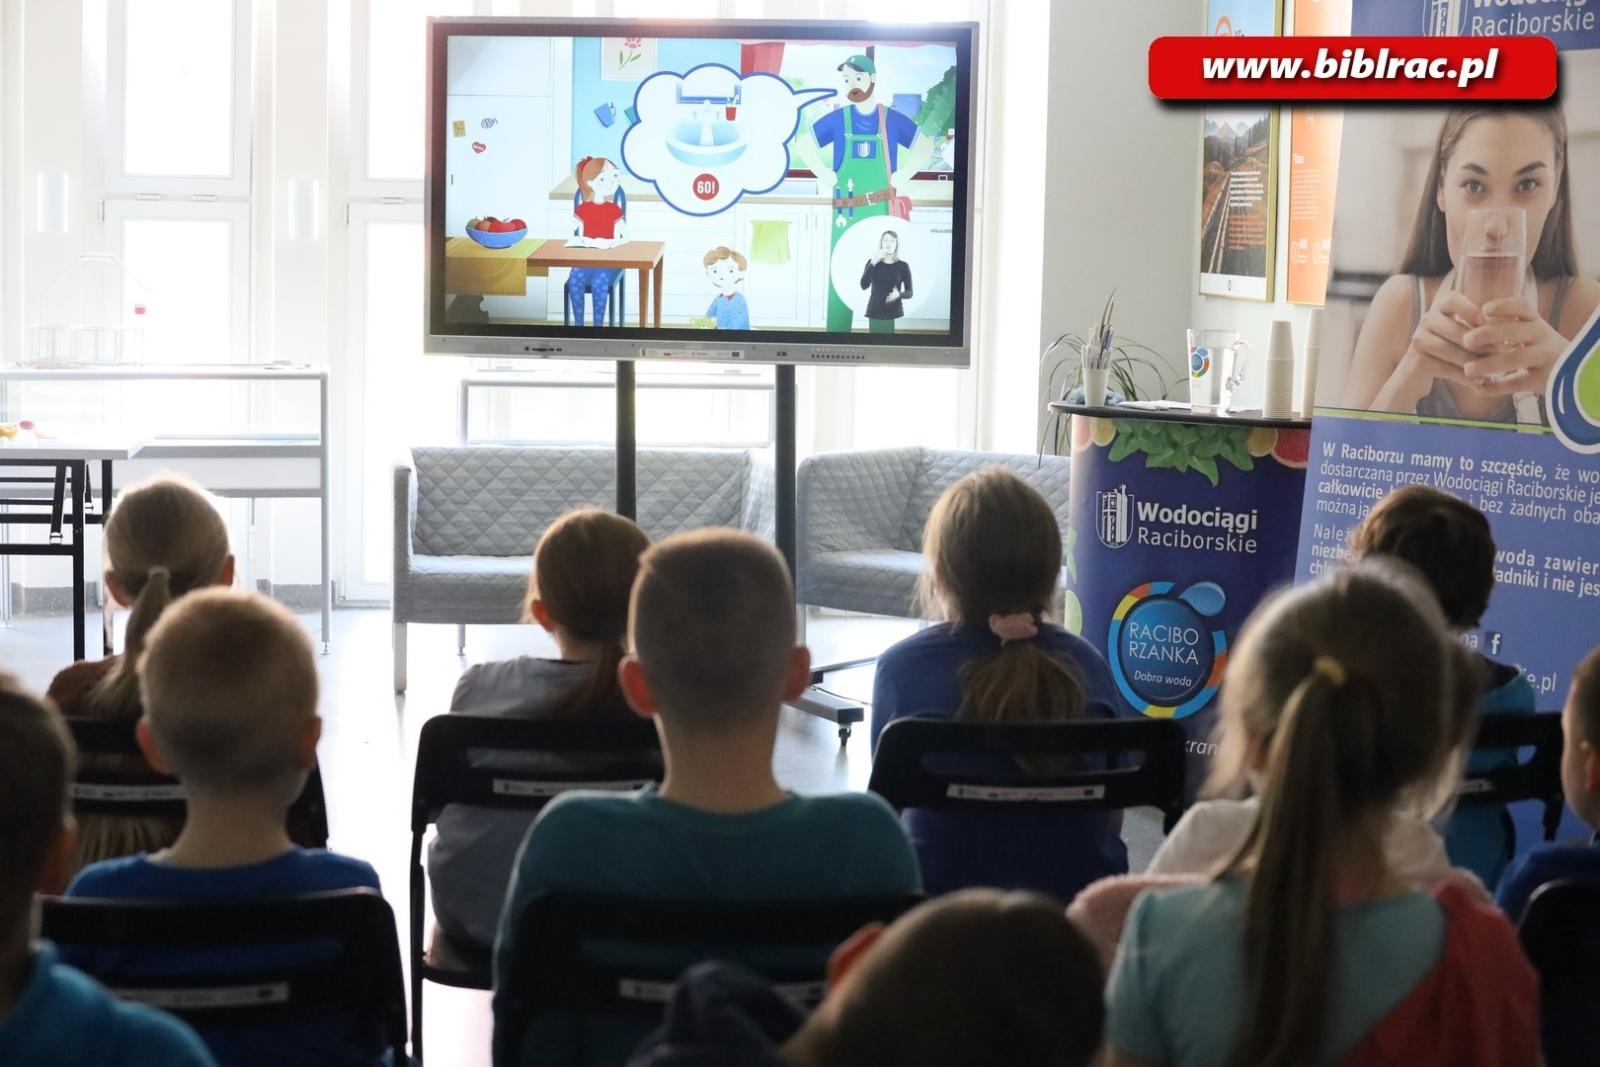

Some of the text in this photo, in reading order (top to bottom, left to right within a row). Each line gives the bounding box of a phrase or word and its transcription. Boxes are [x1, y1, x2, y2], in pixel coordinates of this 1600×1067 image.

[1471, 8, 1595, 36] Raciborskie
[1323, 442, 1336, 457] W
[1341, 443, 1404, 464] Raciborzu
[1411, 453, 1453, 471] mamy
[1460, 456, 1474, 471] to
[1481, 459, 1547, 481] szczęście,
[1555, 463, 1570, 481] że
[1320, 460, 1393, 482] dostarczana
[1396, 471, 1430, 486] przez
[1433, 471, 1503, 497] Wodociągi
[1506, 478, 1587, 503] Raciborskie
[1316, 499, 1356, 515] można
[1318, 479, 1384, 500] całkowicie
[1480, 496, 1503, 513] bez
[1510, 499, 1566, 522] żadnych
[1137, 501, 1257, 534] Wodociągi
[1138, 527, 1257, 553] Raciborskie
[1493, 566, 1540, 588] adniki
[1544, 572, 1548, 589] i
[1552, 575, 1575, 593] nie
[1130, 622, 1199, 646] RACIBO
[1129, 641, 1199, 665] RZANKA
[1134, 670, 1192, 687] Dobra woda
